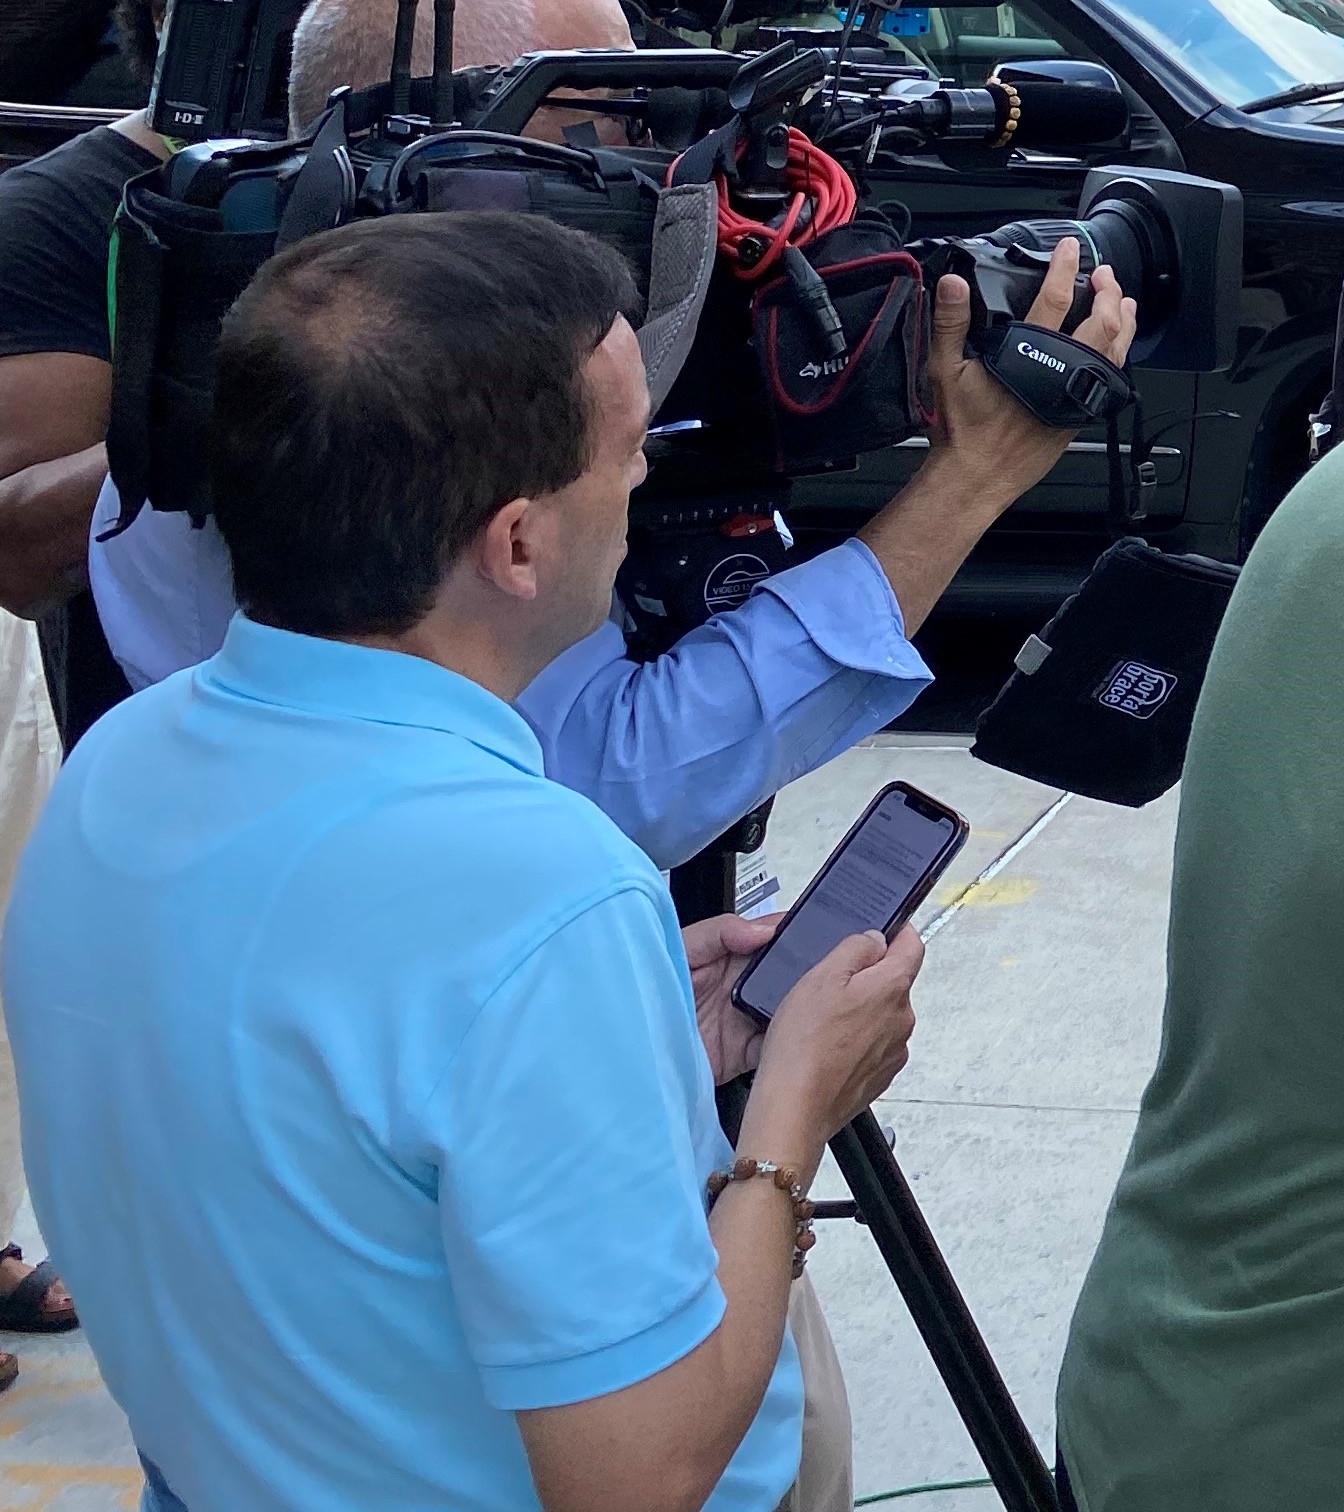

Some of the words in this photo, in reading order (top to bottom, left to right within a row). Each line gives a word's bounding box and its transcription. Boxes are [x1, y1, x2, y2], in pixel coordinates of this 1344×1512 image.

[1017, 341, 1066, 374] Canon
[713, 584, 740, 595] VIDEO
[1105, 665, 1142, 703] brace
[1121, 668, 1167, 710] porta
